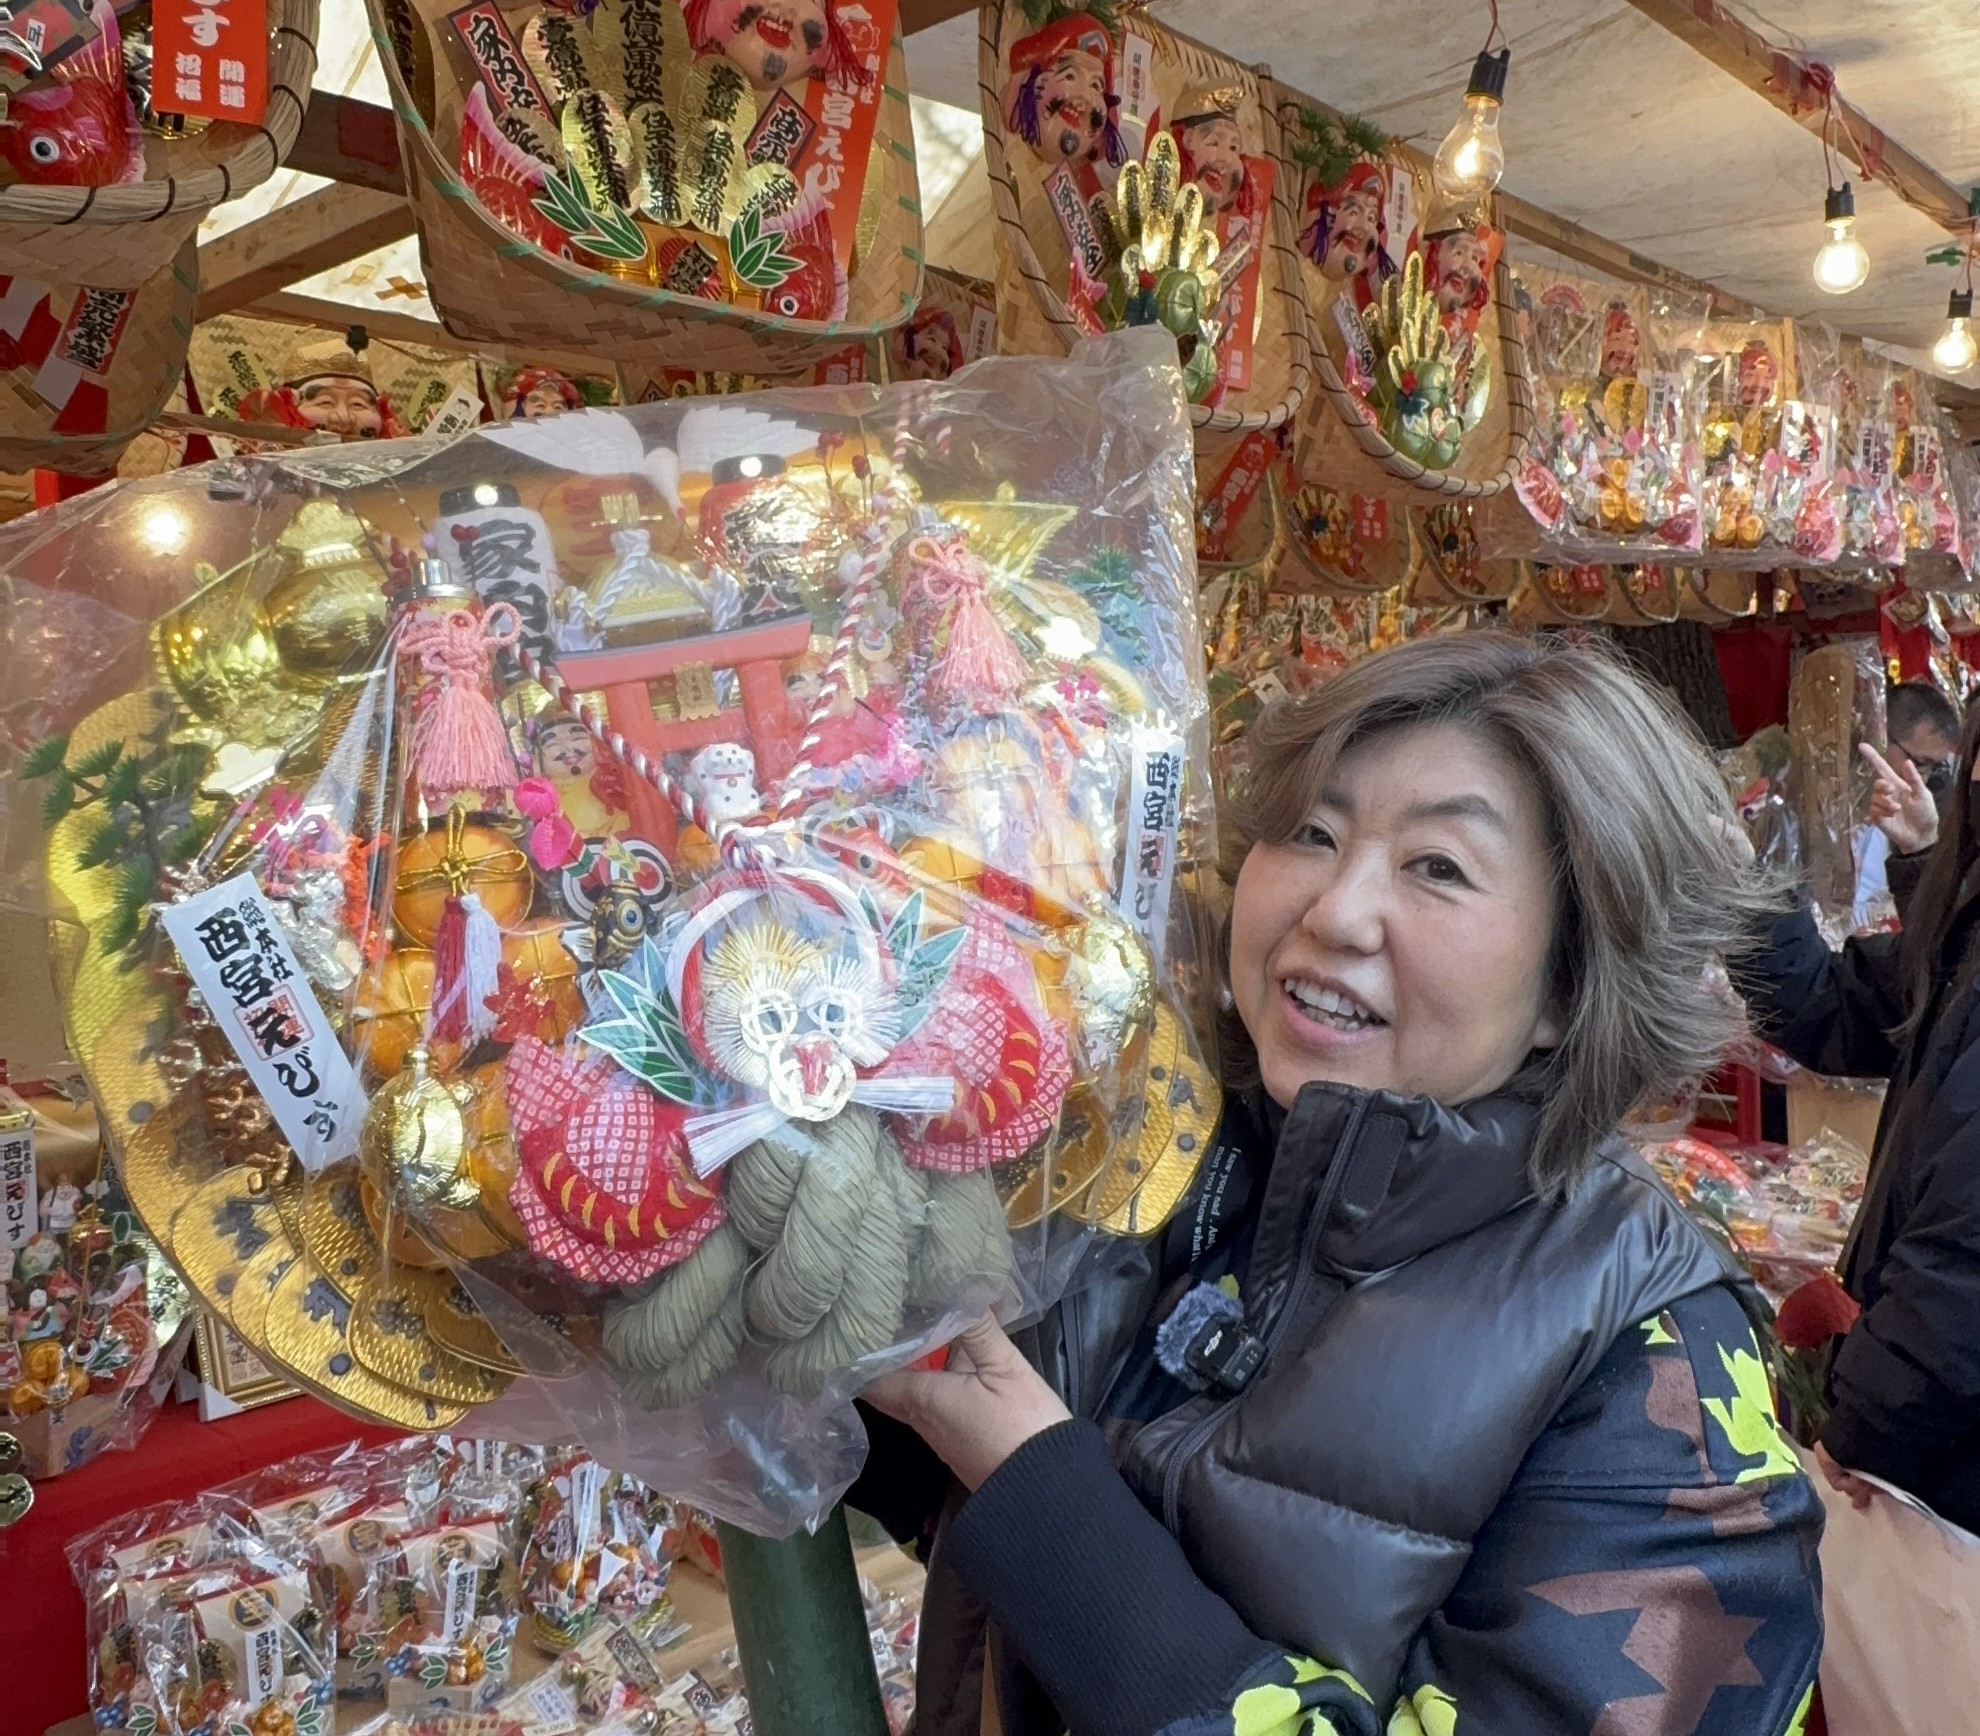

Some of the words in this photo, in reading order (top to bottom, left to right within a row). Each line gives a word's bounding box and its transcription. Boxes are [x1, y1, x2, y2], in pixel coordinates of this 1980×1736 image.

[182, 0, 230, 46] す
[466, 12, 541, 112] 家内安
[1133, 751, 1171, 921] 西宮えび
[194, 905, 339, 1143] 西宮えびす
[3, 1141, 26, 1241] 西宮えびす
[1196, 1193, 1211, 1224] know
